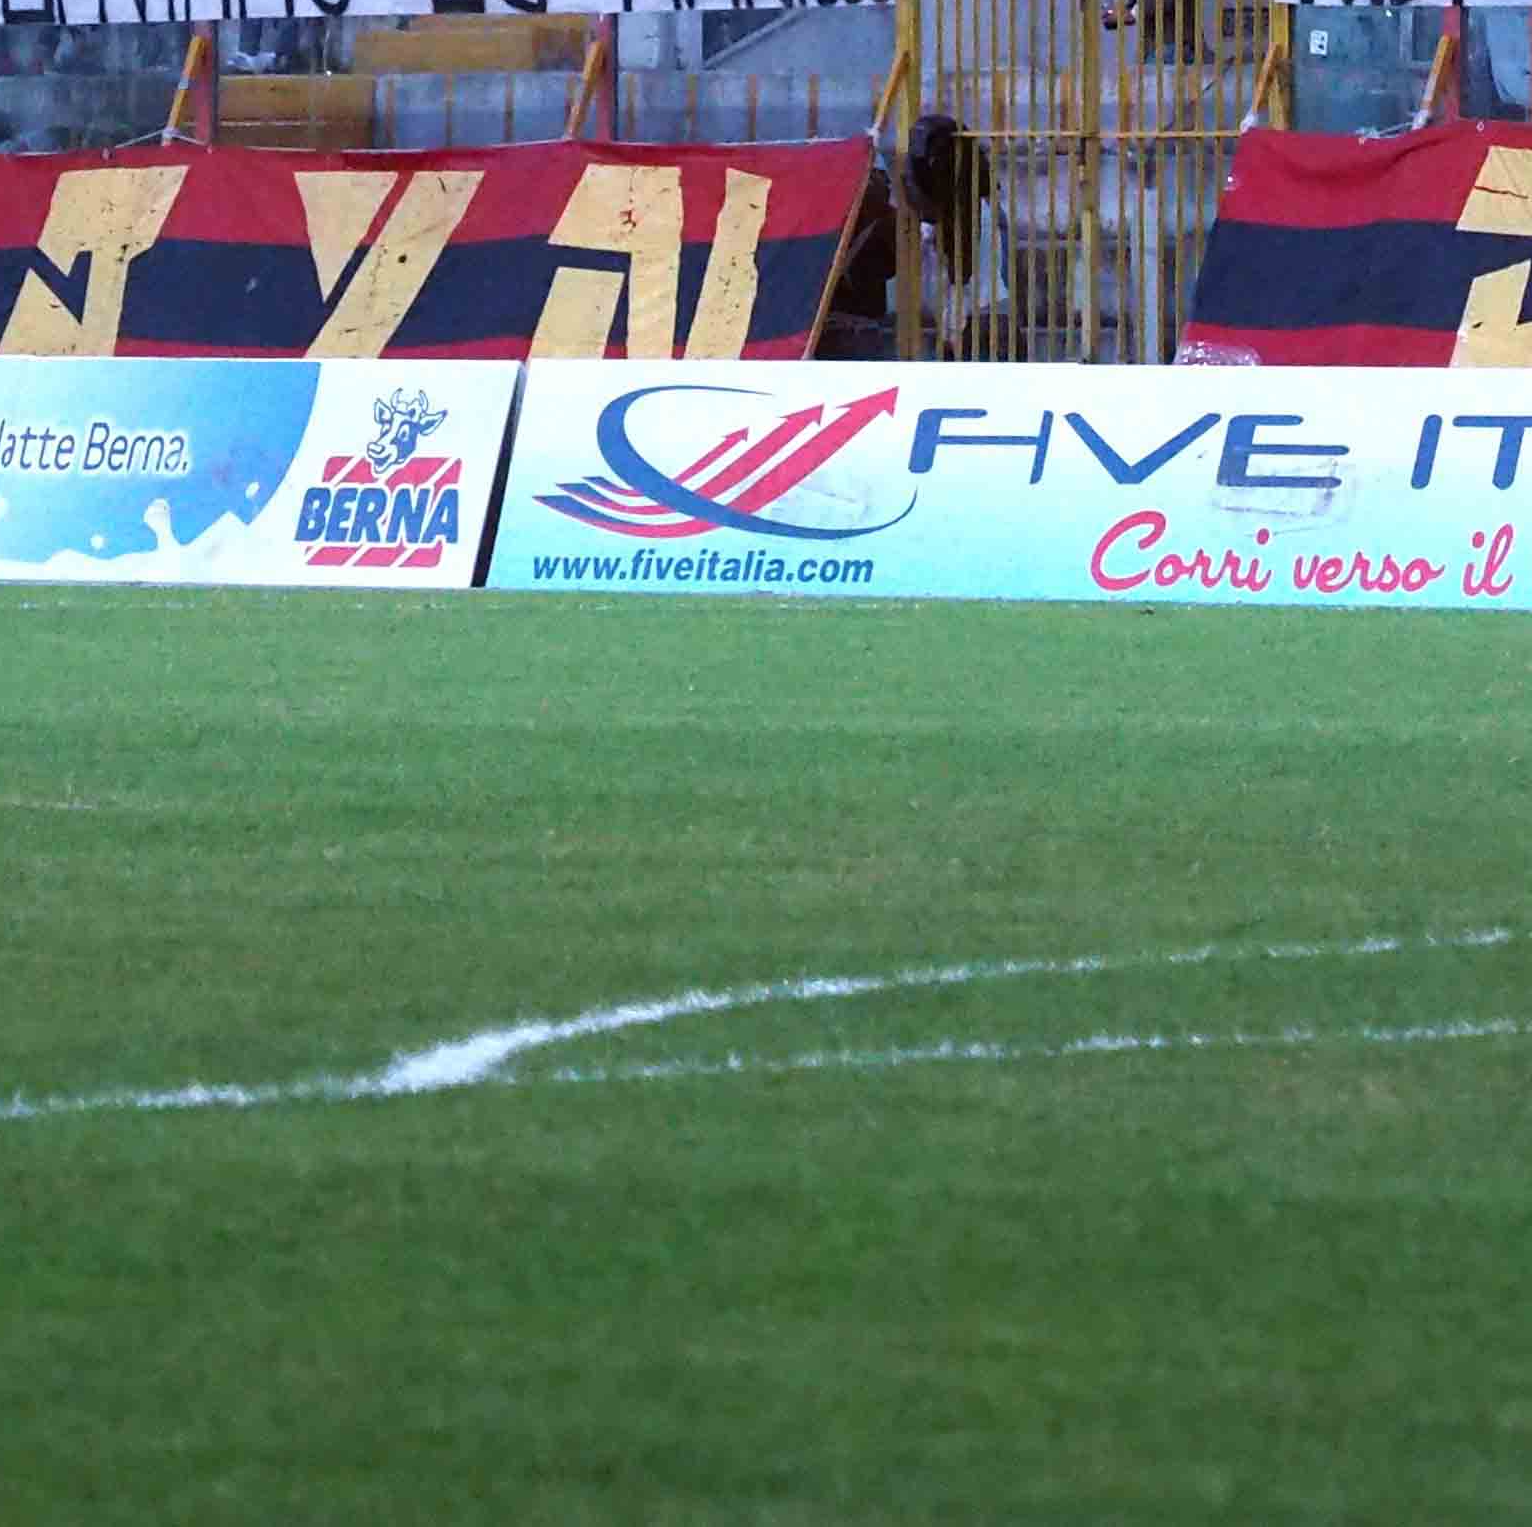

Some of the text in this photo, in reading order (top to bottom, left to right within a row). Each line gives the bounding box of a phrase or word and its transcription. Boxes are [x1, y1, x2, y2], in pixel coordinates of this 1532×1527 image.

[907, 408, 1351, 490] FIVE
[293, 487, 460, 544] BERNA
[531, 549, 875, 584] www.fiveitalia.com
[1090, 510, 1274, 593] Corri
[1293, 552, 1447, 594] verso
[1462, 523, 1516, 597] il
